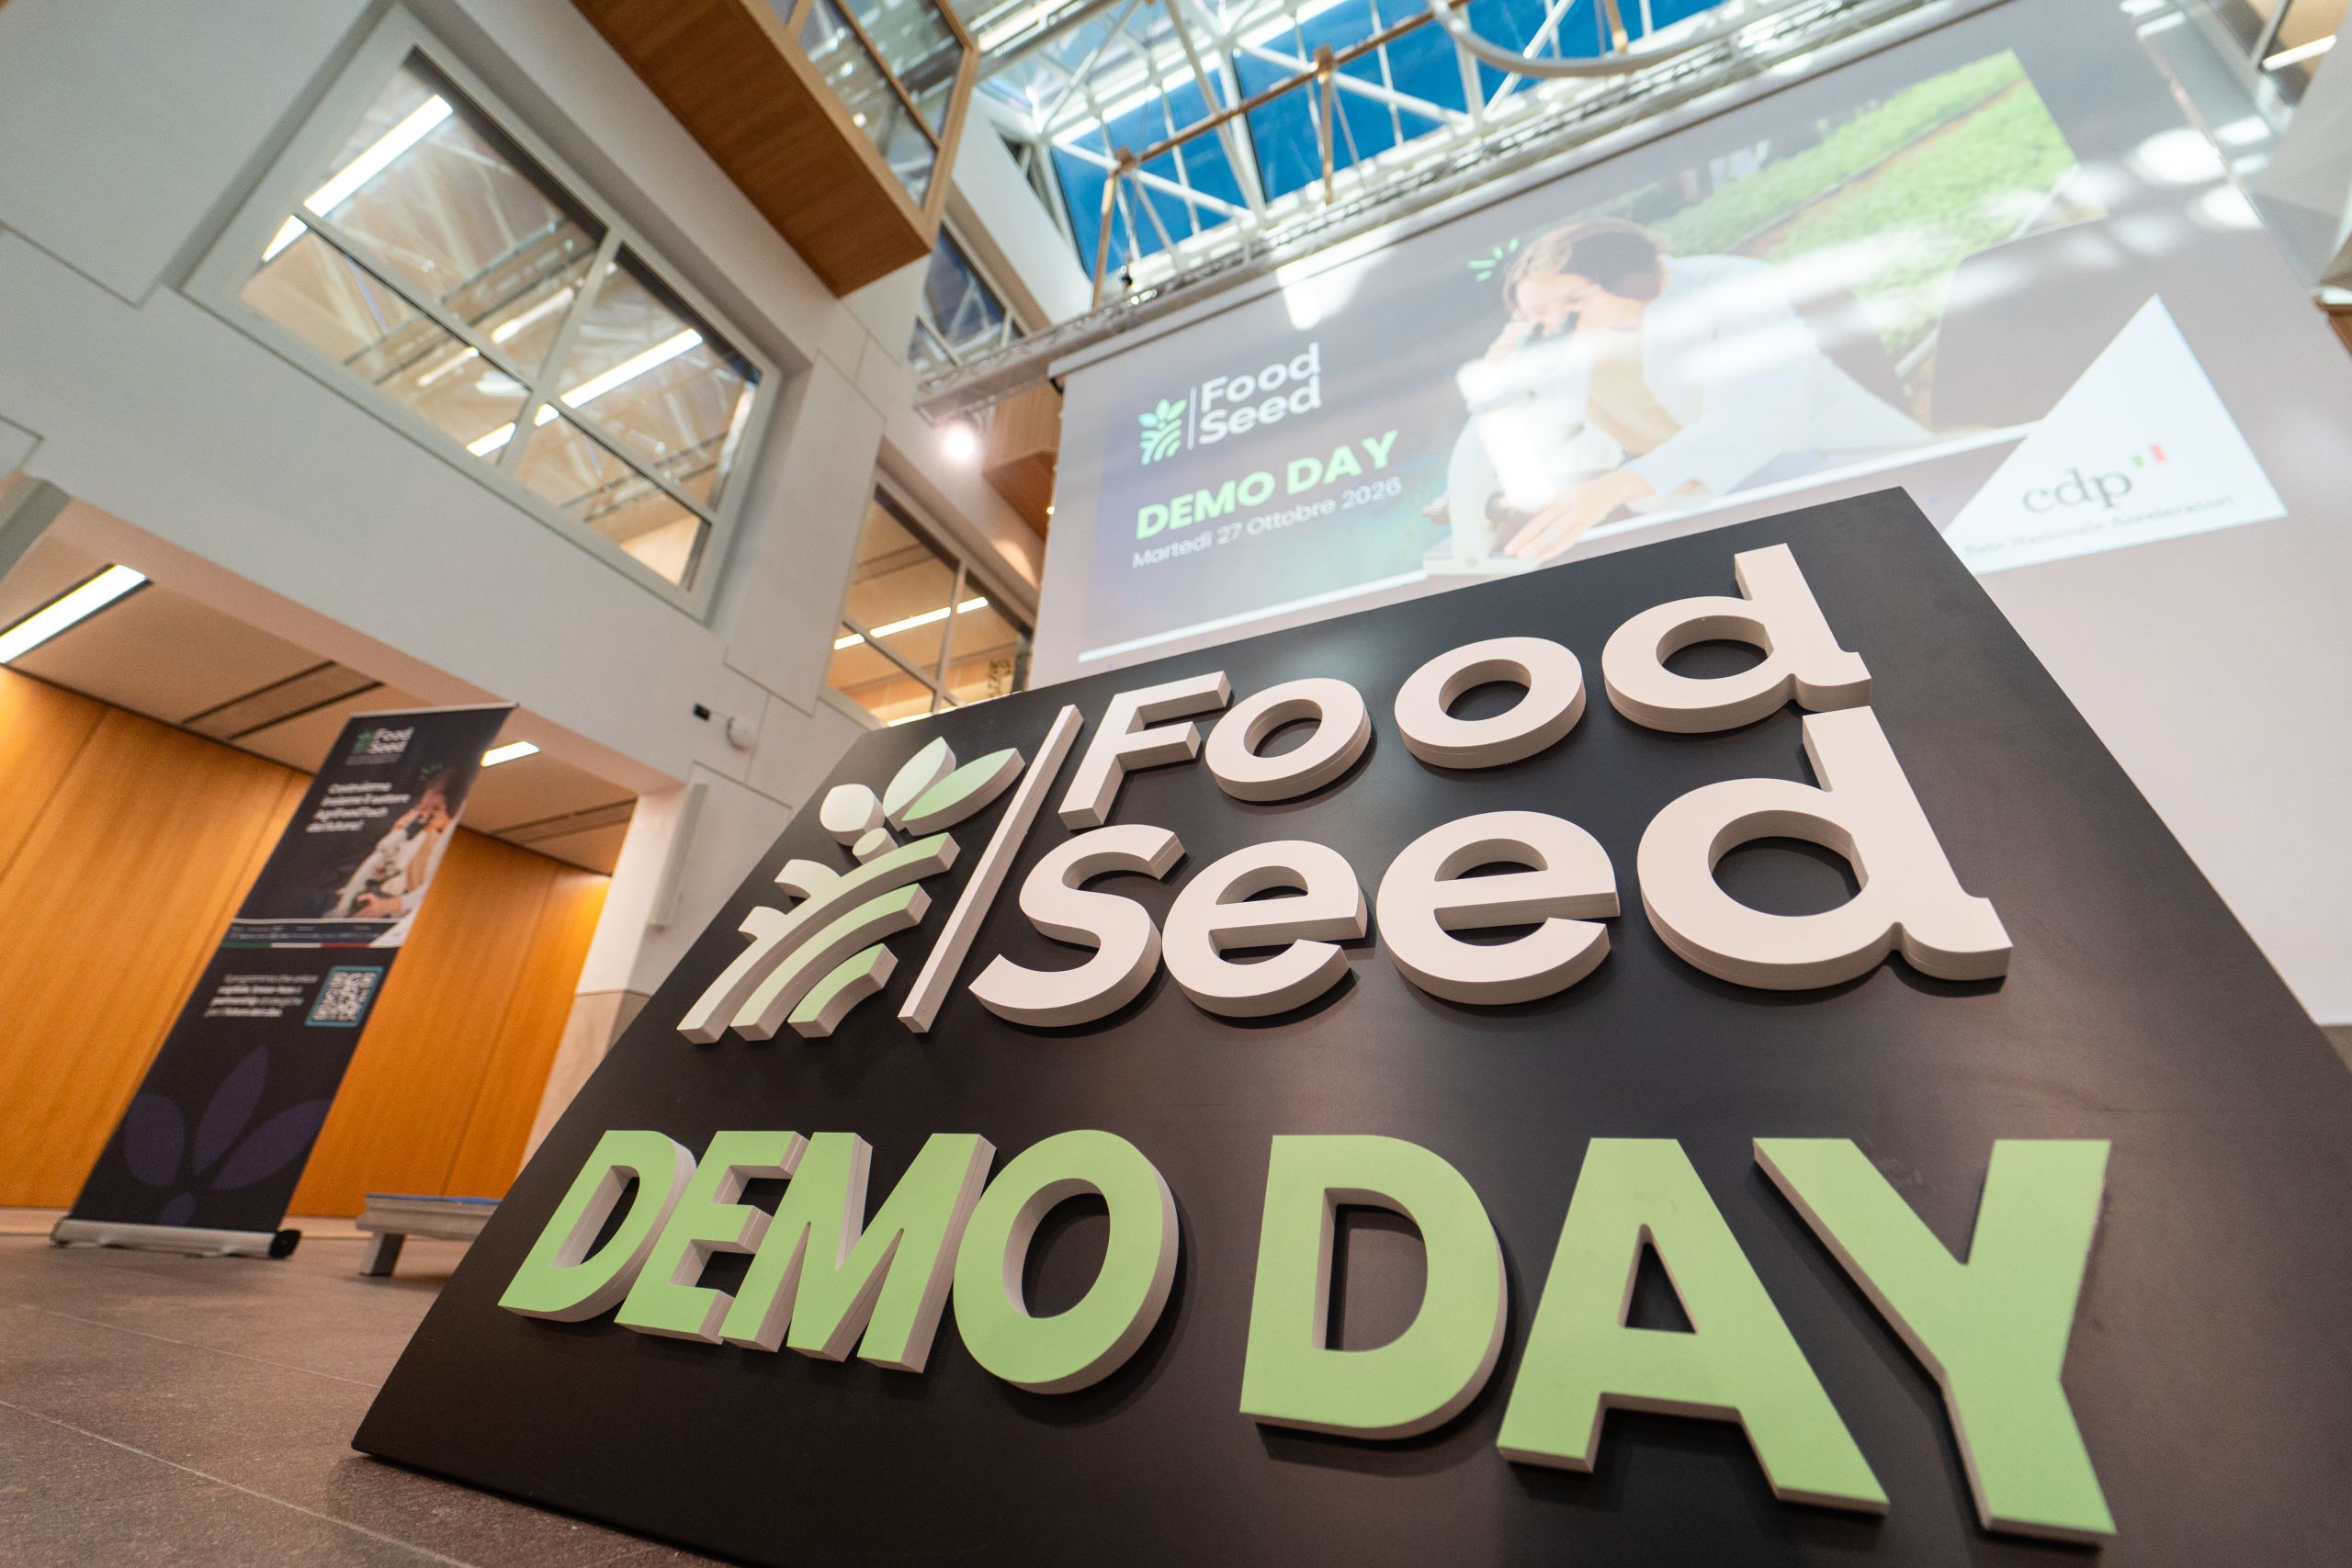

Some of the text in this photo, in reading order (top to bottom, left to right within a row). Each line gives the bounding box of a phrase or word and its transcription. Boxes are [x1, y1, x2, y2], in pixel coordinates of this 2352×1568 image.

[1198, 375, 1322, 445] Seed
[1201, 341, 1321, 413] Food
[1136, 429, 1399, 540] DEMO DAY
[1217, 521, 1242, 545] 27
[1247, 499, 1336, 536] Ottobre
[1341, 476, 1402, 510] 2026
[2022, 467, 2132, 513] cdp
[1058, 542, 1871, 832] Food
[968, 705, 2012, 1028] Seed
[497, 1129, 2115, 1543] DEMO DAY
